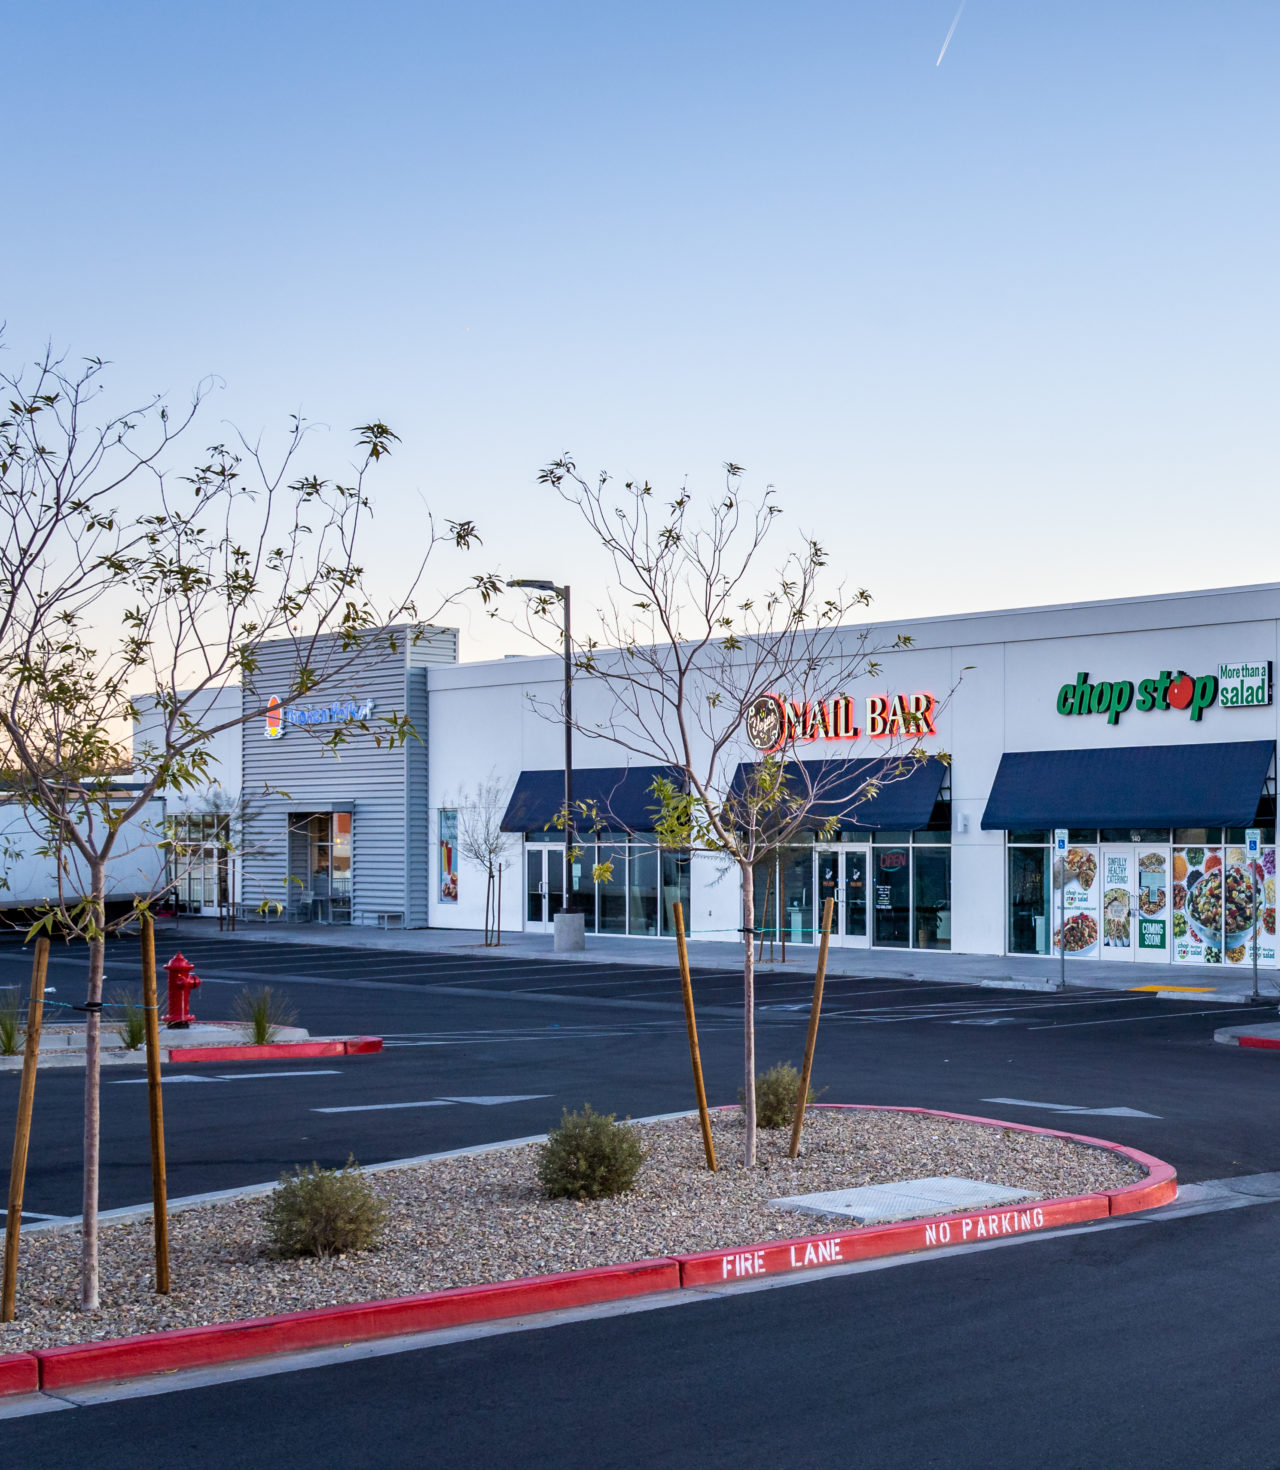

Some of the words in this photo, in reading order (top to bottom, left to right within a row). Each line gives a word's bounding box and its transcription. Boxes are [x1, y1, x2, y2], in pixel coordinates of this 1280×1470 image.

[1220, 664, 1241, 679] More
[1241, 663, 1260, 677] than
[1261, 666, 1266, 677] a
[1056, 672, 1134, 725] chop
[1136, 670, 1218, 721] stop
[1220, 678, 1266, 706] salad
[785, 698, 859, 738] NAIL
[865, 694, 934, 736] BAR
[880, 853, 907, 868] OPEN
[1108, 857, 1128, 867] SINFULLY
[1108, 867, 1127, 876] HEALTHY
[1142, 922, 1164, 935] COMING
[925, 1222, 950, 1245] NO
[962, 1207, 1044, 1239] PARKING
[722, 1250, 766, 1279] FIRE
[790, 1238, 843, 1267] LANE
